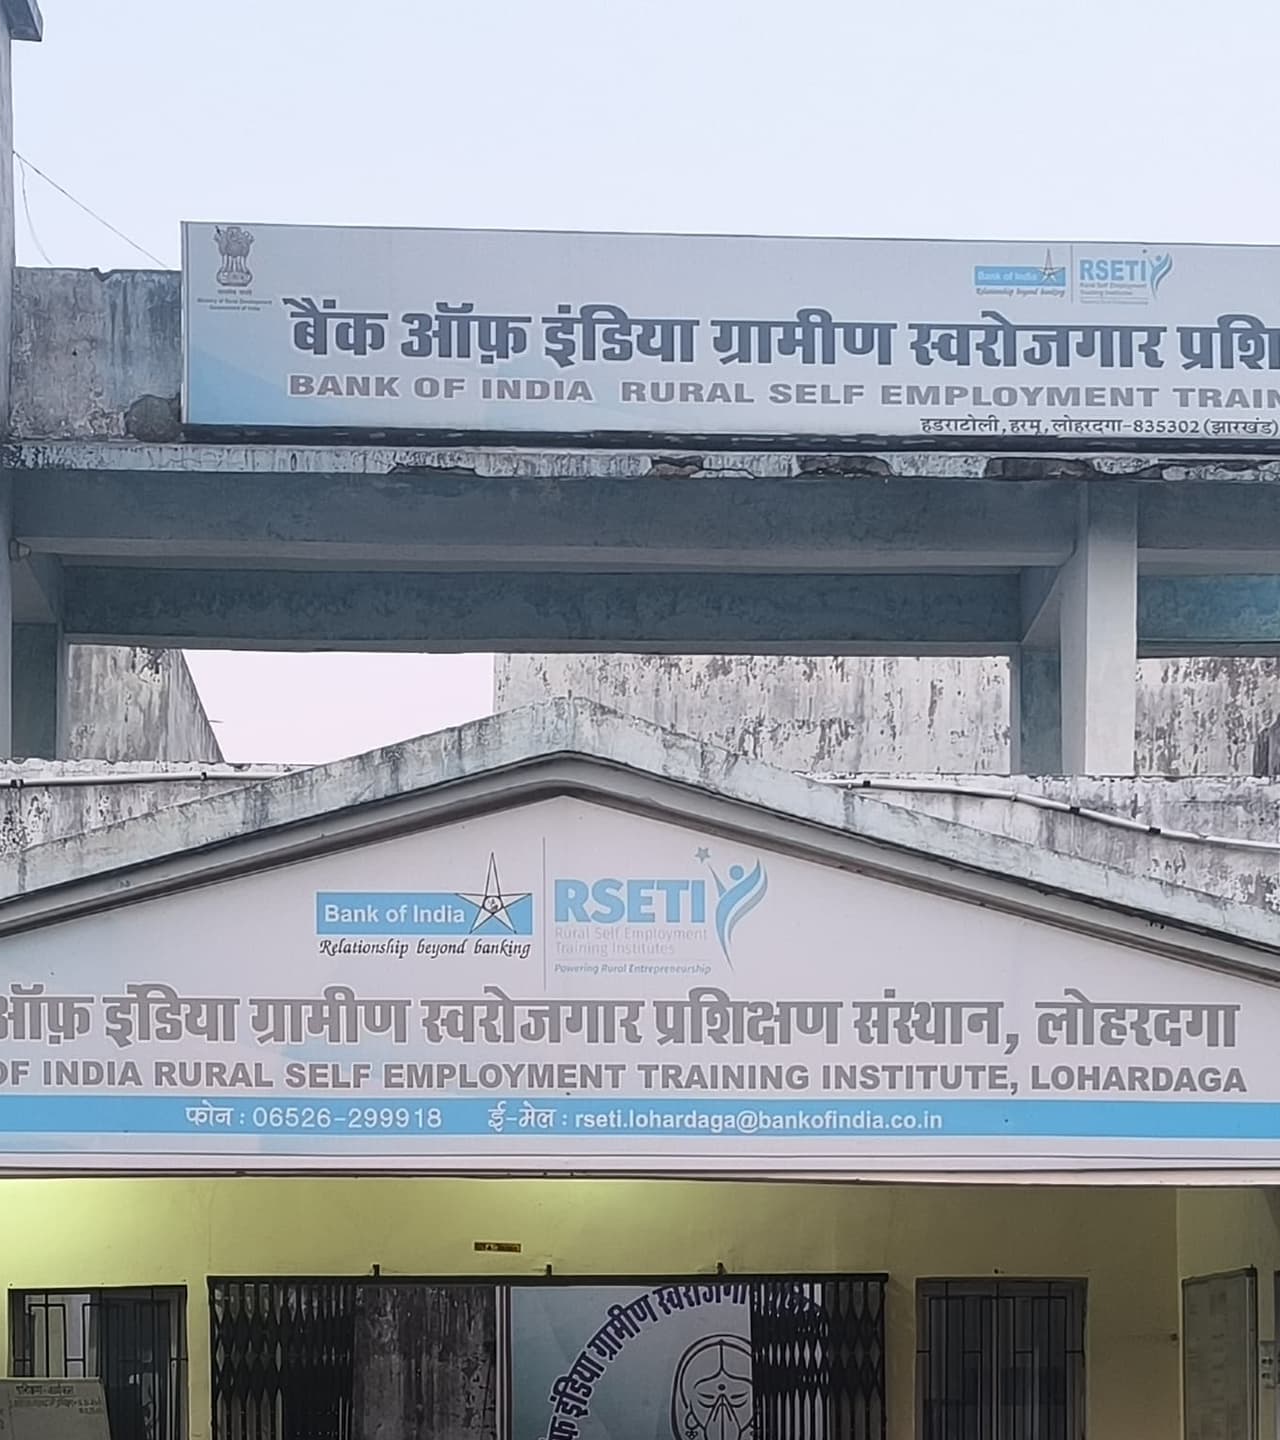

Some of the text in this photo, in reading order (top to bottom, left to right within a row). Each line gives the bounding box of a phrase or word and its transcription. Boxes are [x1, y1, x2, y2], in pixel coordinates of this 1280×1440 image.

[1080, 259, 1146, 281] RSETI
[282, 298, 388, 356] बैंक
[401, 302, 531, 364] ऑफ़
[542, 304, 699, 368] इंडिया
[711, 308, 897, 366] ग्रामीण
[908, 311, 1167, 368] स्वरोजगार
[289, 374, 400, 397] BANK
[414, 377, 465, 399] OF
[482, 379, 593, 401] INDIA
[621, 381, 755, 404] RURAL
[769, 383, 865, 405] SELF
[881, 385, 1160, 408] EMPLOYMENT
[324, 904, 465, 923] Bank of India
[554, 878, 705, 924] RSETI
[319, 938, 531, 959] Relationship beyond banking
[555, 927, 707, 944] Rural Self Employment
[556, 942, 608, 957] Training
[554, 963, 599, 975] Powering
[601, 963, 627, 974] Rural
[248, 986, 412, 1047] ग्रामीण
[421, 986, 646, 1046] स्वरोजगार
[654, 986, 843, 1047] प्रशिक्षण
[853, 988, 1019, 1055] संस्थान,
[1035, 988, 1241, 1048] लोहरदगा
[43, 1060, 143, 1086] INDIA
[154, 1062, 274, 1088] RURAL
[285, 1062, 371, 1089] SELF
[384, 1063, 627, 1090] EMPLOYMENT
[637, 1064, 809, 1090] TRAINING
[822, 1064, 1018, 1096] INSTITUTE,
[1031, 1065, 1248, 1093] LOHARDAGA
[185, 1100, 234, 1128] फोन
[252, 1106, 443, 1130] 06526-299918
[487, 1100, 557, 1132] ई-मेल
[575, 1107, 943, 1134] rseti.lohardaga@bankofindia.co.in
[550, 1350, 605, 1418] इंडिया
[587, 1294, 659, 1361] ग्रामीण
